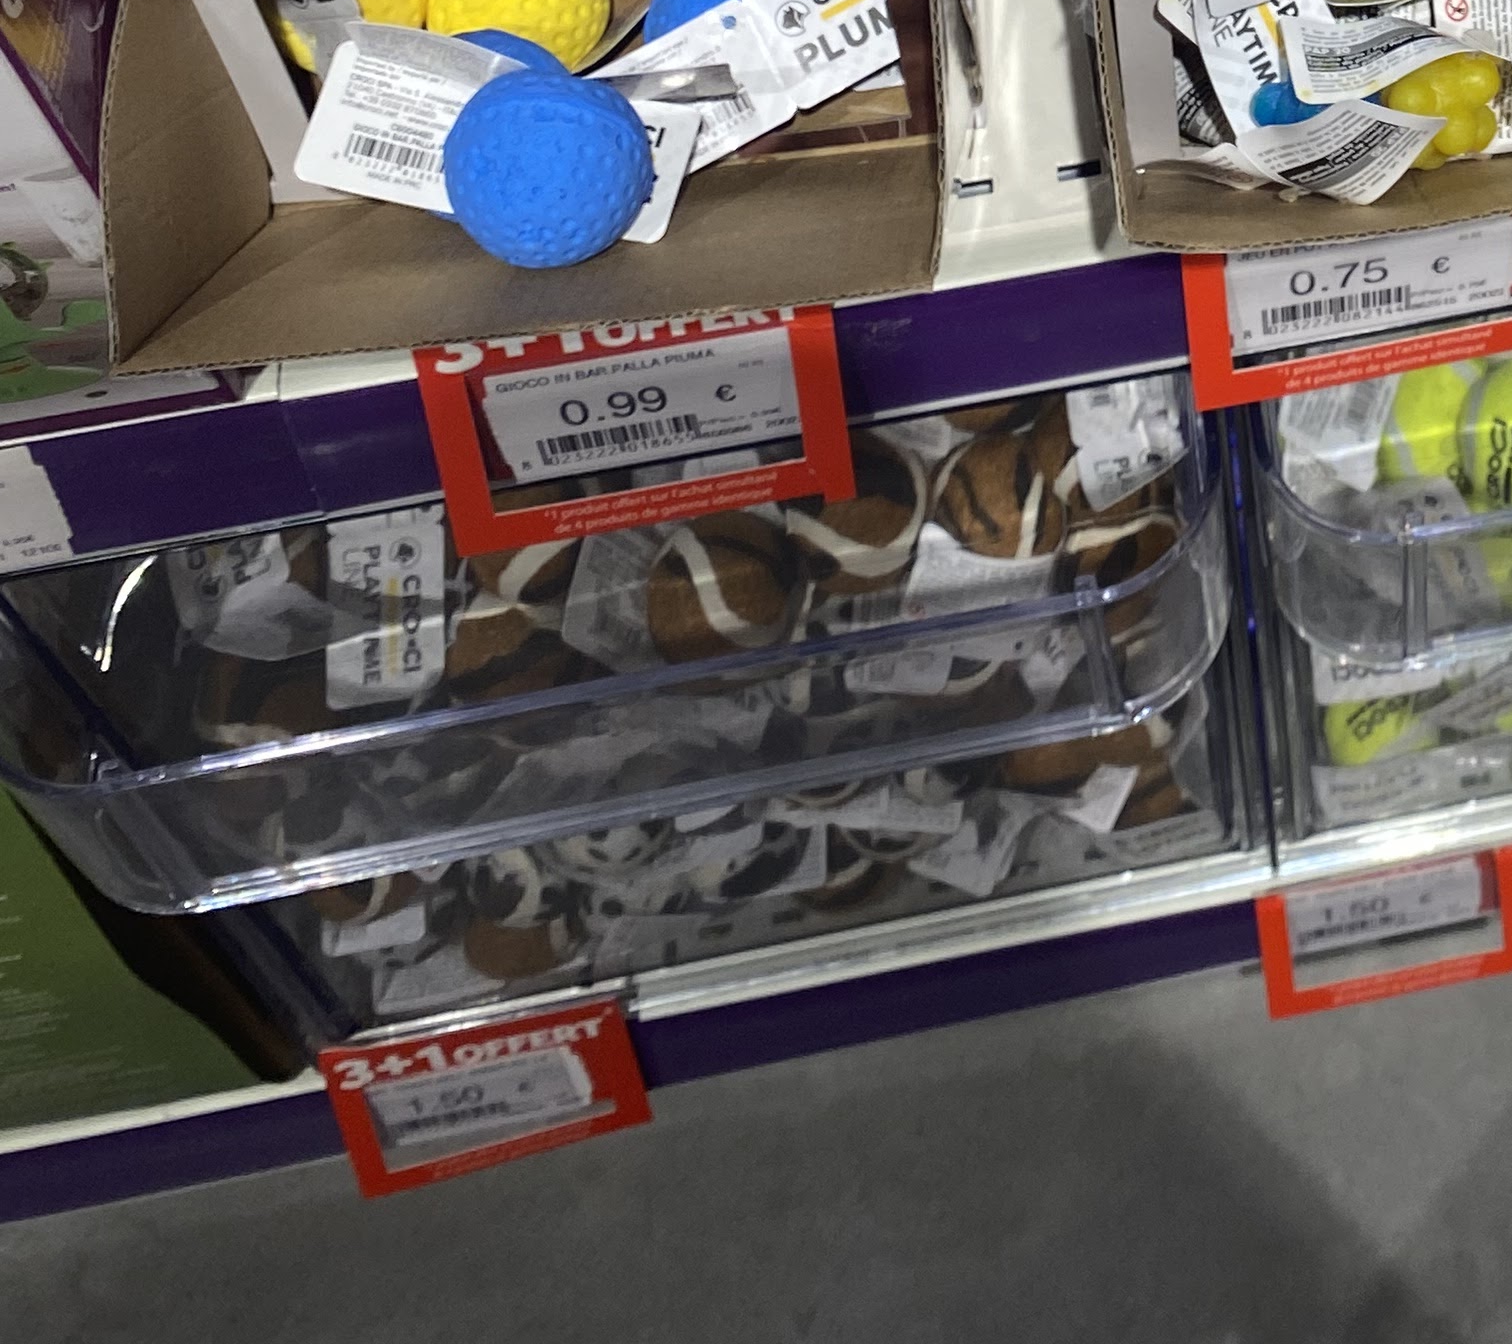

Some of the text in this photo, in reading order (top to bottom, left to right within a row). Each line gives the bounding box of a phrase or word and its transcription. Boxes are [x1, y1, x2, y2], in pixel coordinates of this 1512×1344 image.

[1290, 256, 1451, 296] 0.75 €
[496, 376, 550, 394] GIOCO
[560, 384, 737, 426] 0.99 €
[333, 1042, 447, 1092] 3+1
